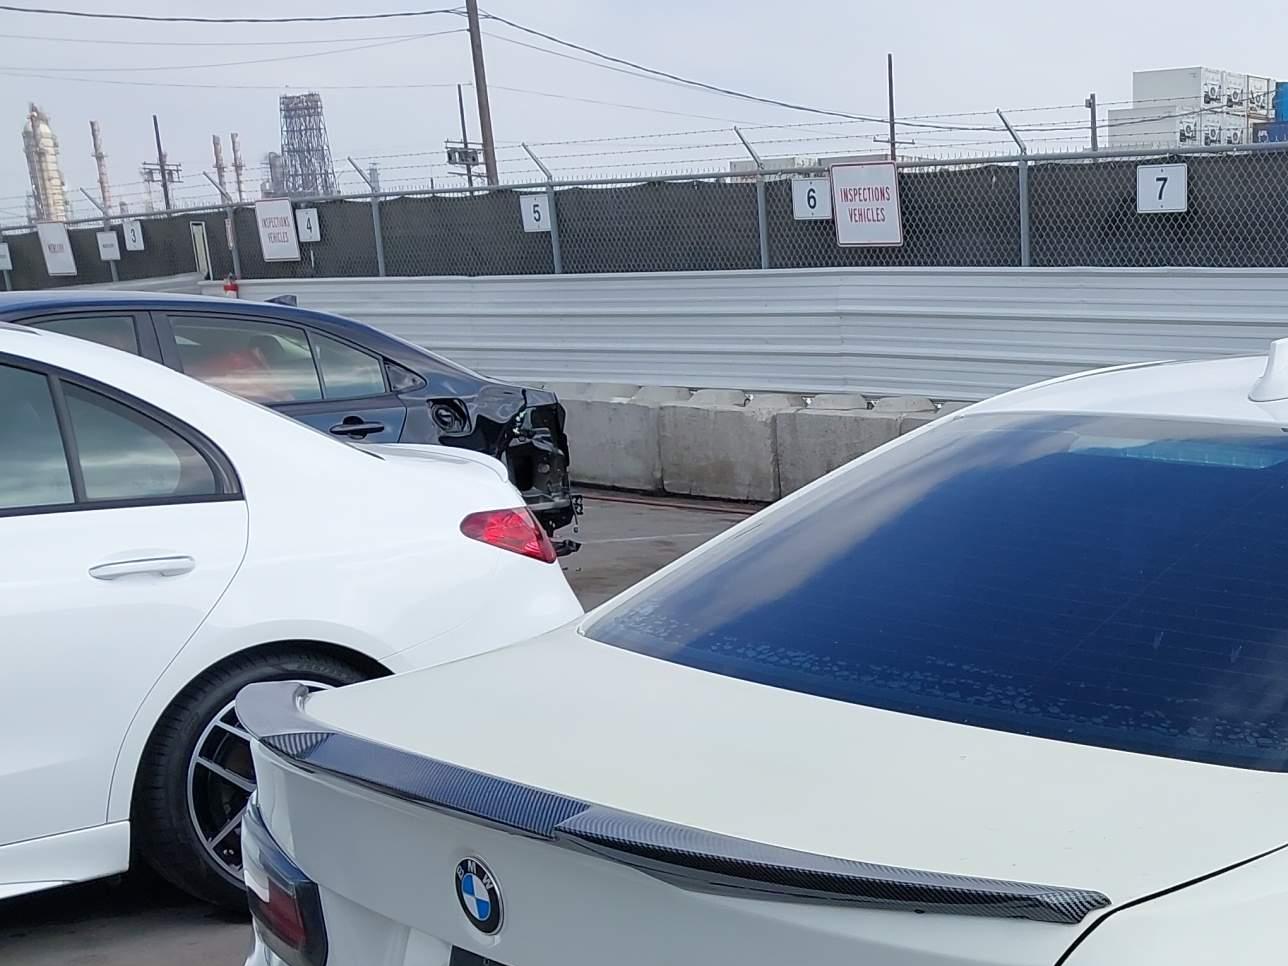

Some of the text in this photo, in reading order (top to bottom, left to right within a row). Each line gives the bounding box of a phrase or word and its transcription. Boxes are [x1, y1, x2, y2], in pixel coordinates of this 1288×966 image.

[840, 186, 891, 203] INSPECTIONS
[1155, 177, 1169, 201] 7
[806, 188, 817, 209] 6
[532, 203, 541, 222] 5
[847, 207, 886, 223] VEHICLES
[306, 217, 313, 234] 4
[130, 228, 137, 243] 3
[456, 860, 495, 890] BMW
